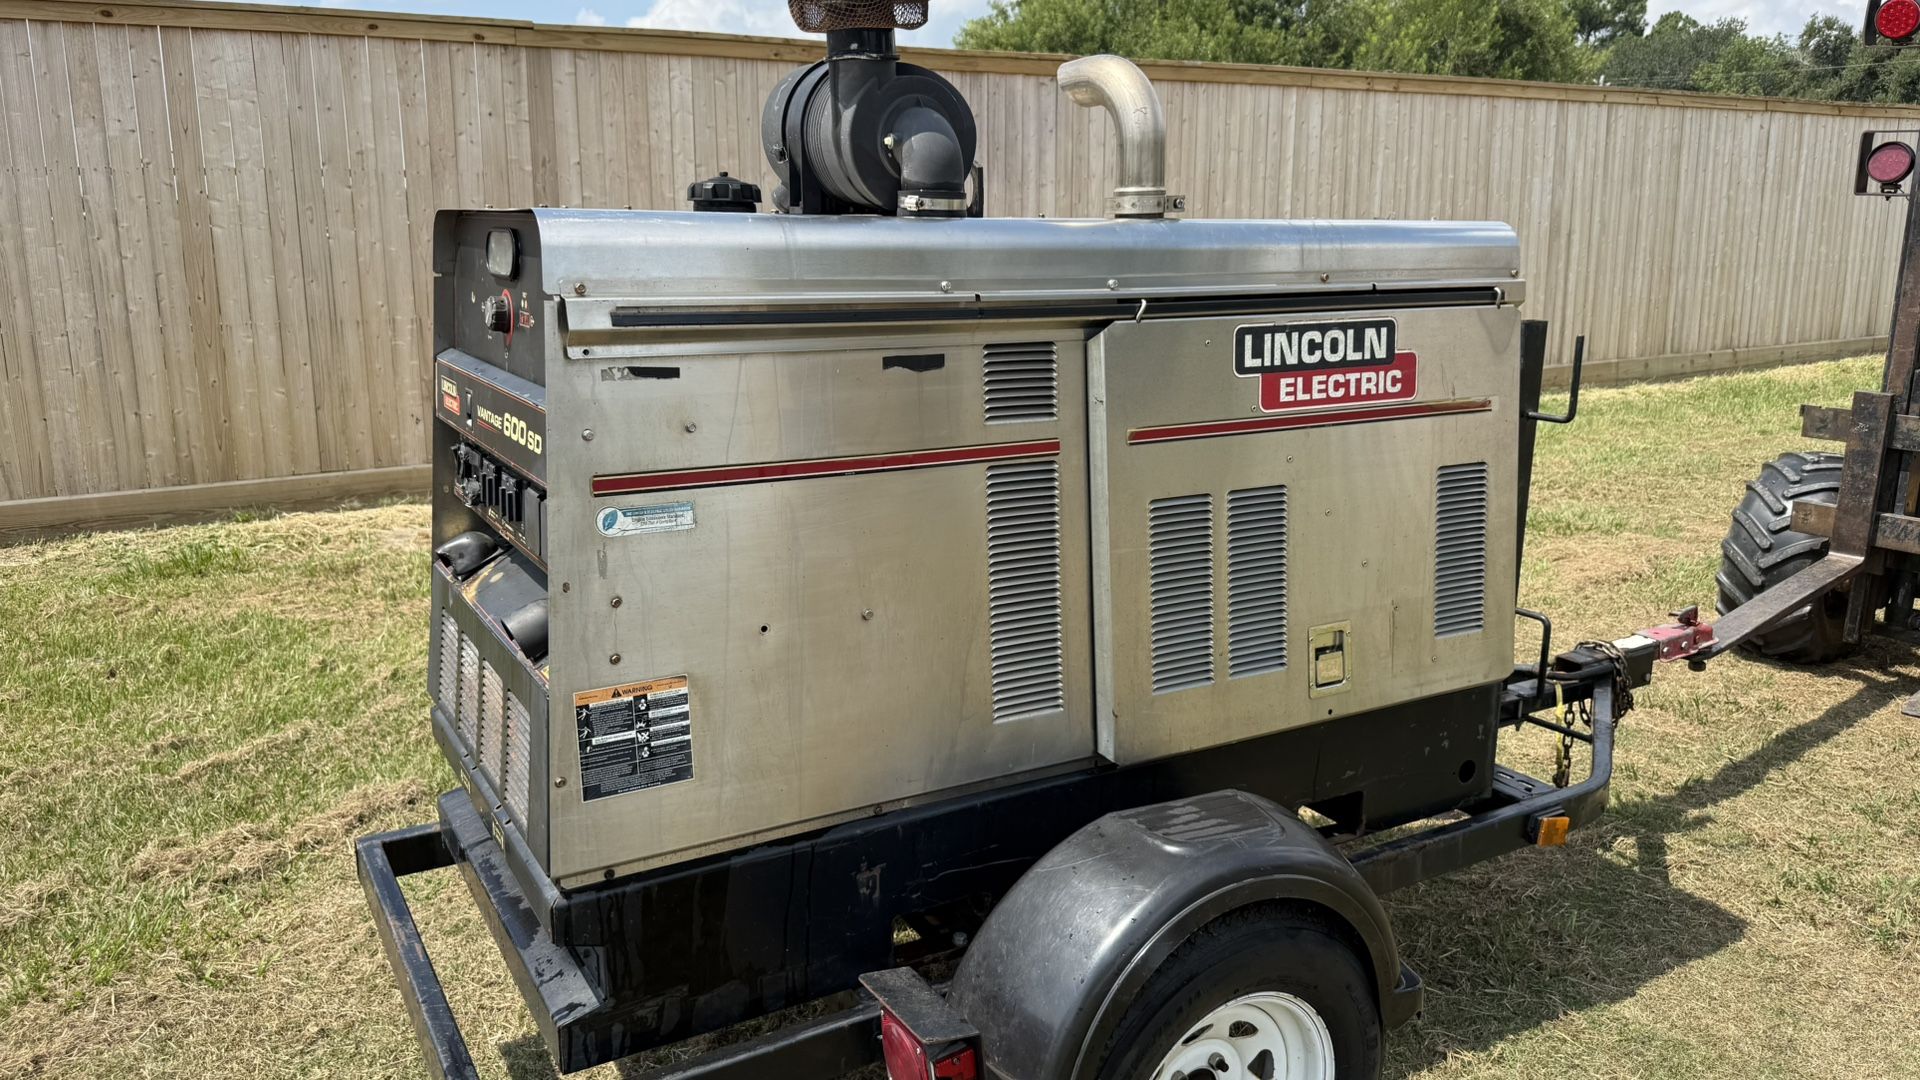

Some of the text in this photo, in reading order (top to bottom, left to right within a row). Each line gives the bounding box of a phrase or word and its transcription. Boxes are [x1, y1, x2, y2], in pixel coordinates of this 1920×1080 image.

[1244, 327, 1387, 367] LINCOLN
[1280, 369, 1402, 402] ELECTRIC
[477, 405, 542, 455] VANTAGE 600 SD
[621, 684, 653, 695] WARNING
